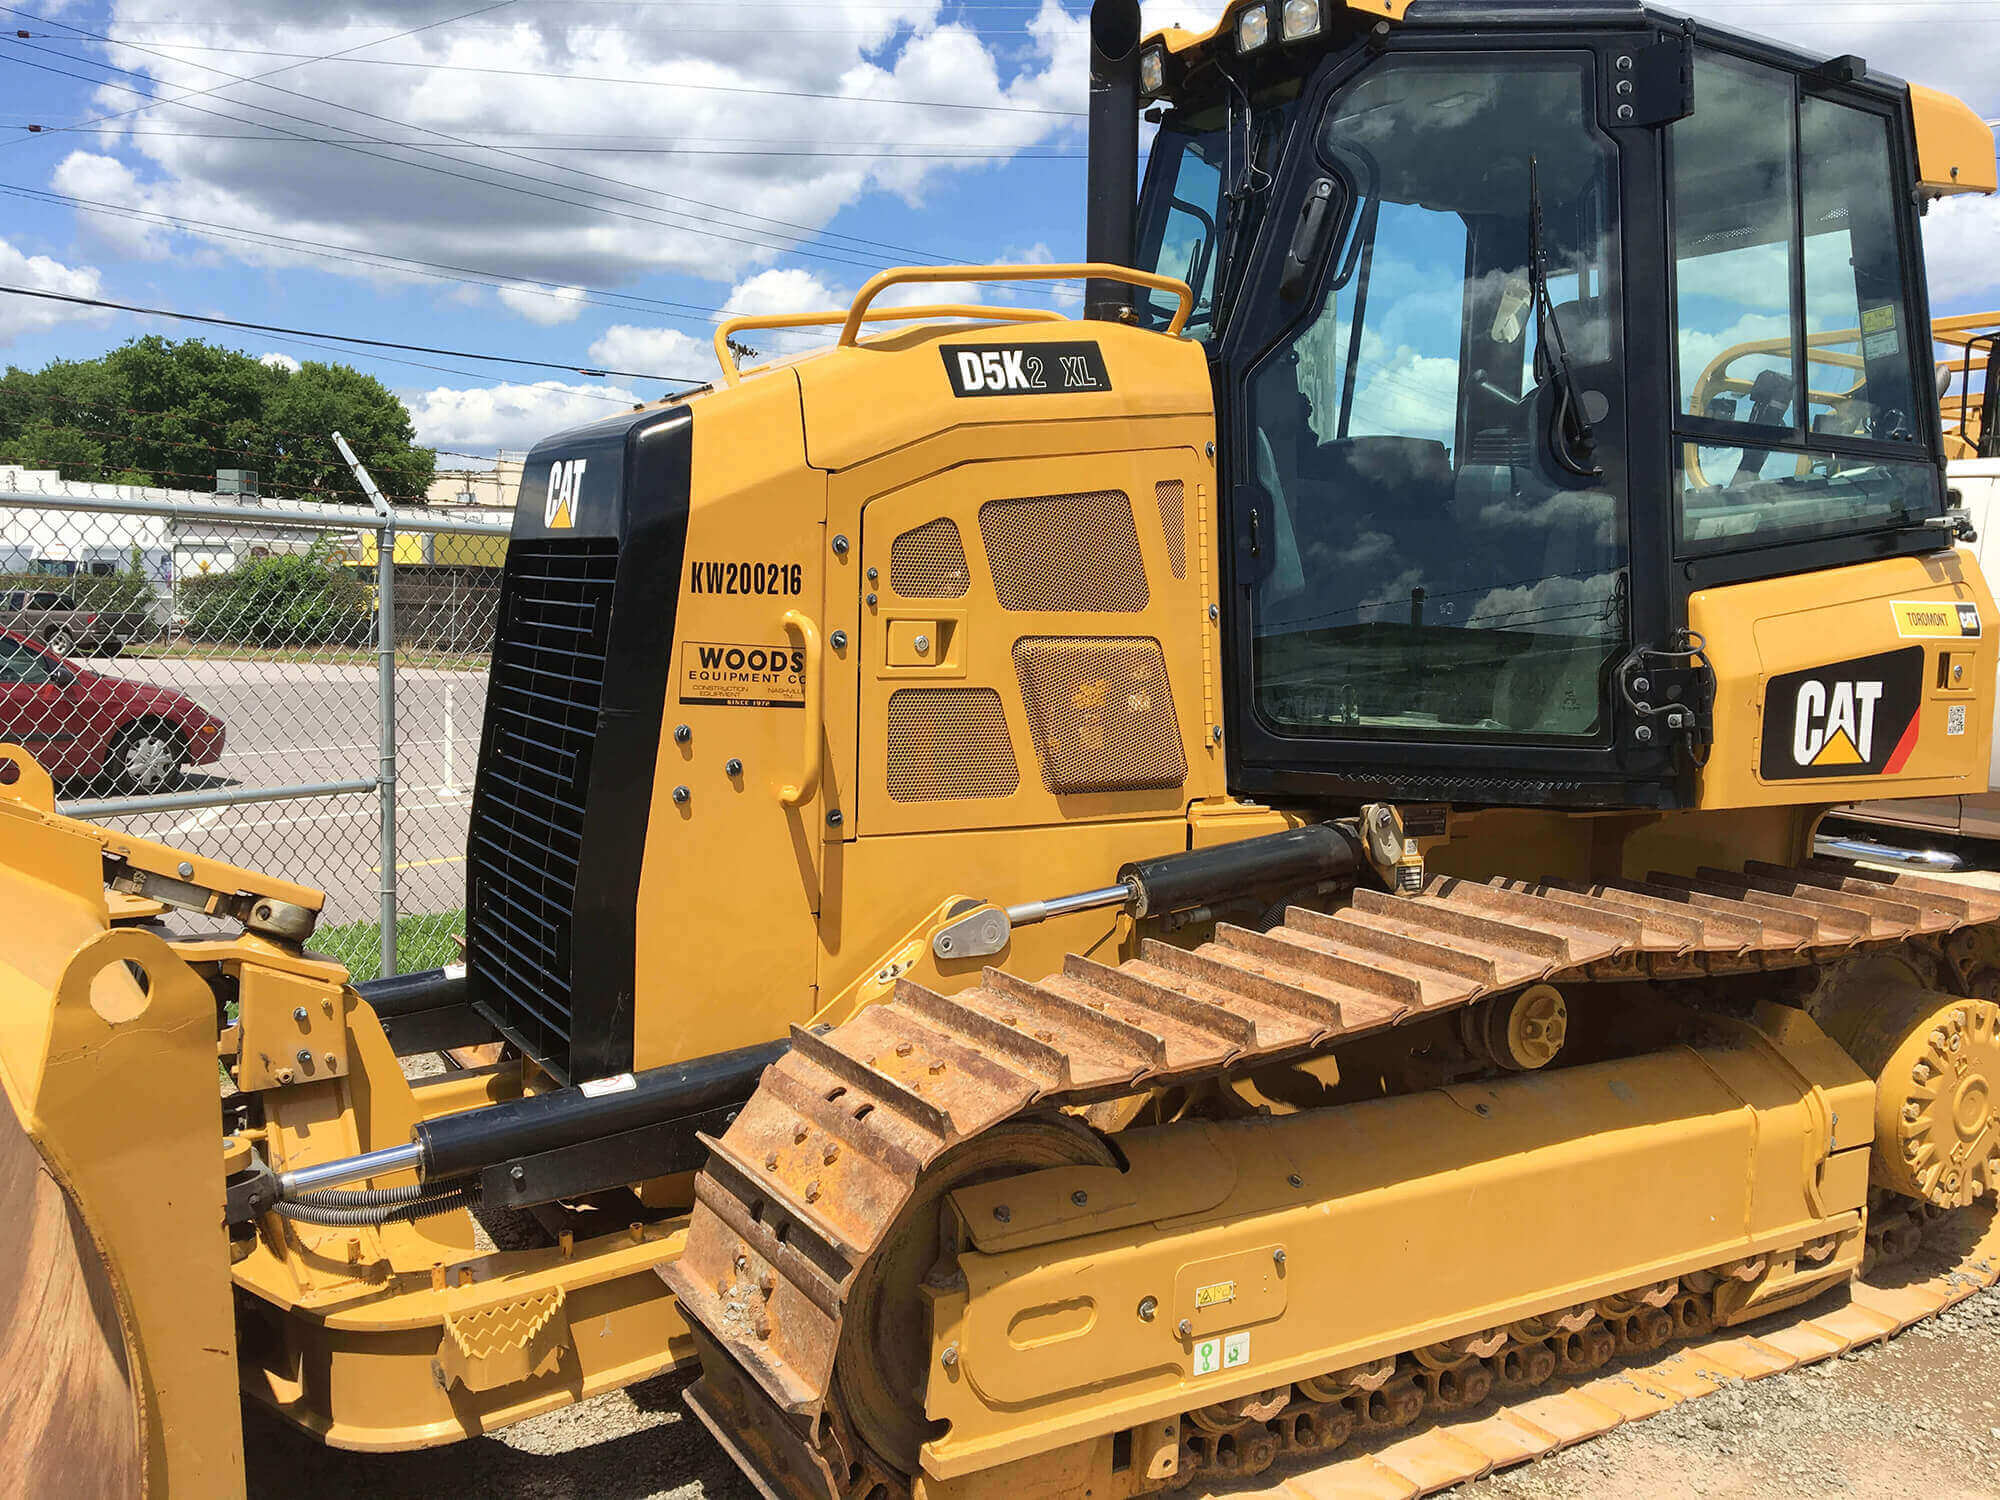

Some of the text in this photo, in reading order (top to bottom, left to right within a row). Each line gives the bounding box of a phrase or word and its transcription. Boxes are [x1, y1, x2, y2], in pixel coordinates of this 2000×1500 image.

[1059, 356, 1096, 387] XL
[544, 458, 587, 528] CAT
[691, 561, 802, 595] KW200216
[1905, 611, 1978, 629] TOROMONT CAT
[699, 647, 804, 673] WOODS
[689, 670, 780, 683] EQUIPMENT
[692, 684, 749, 693] CONSTRUCTION
[699, 690, 741, 698] EQUIPMENT
[1793, 680, 1883, 766] CAT
